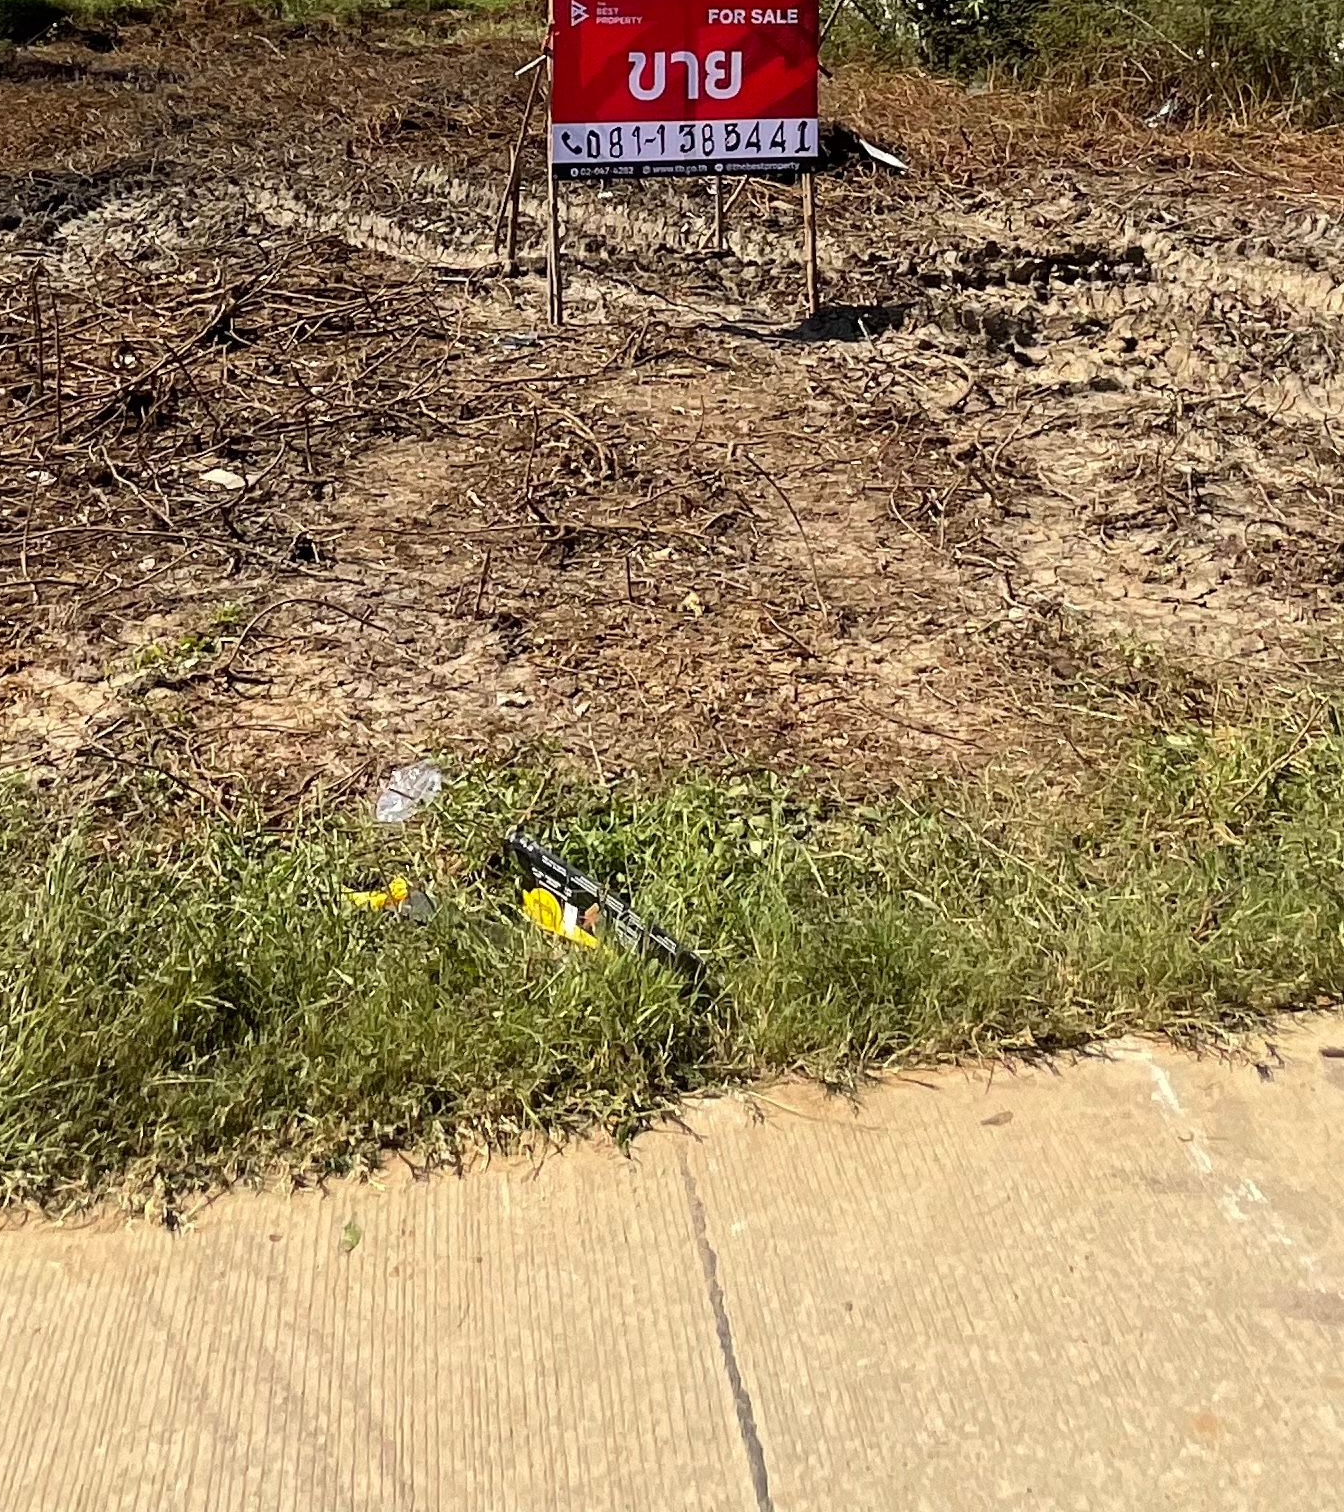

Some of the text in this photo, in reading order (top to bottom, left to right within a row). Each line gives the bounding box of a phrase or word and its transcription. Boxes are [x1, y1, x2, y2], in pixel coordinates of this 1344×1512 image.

[597, 7, 619, 16] BEST
[708, 8, 798, 24] FOR SALE
[596, 16, 643, 25] PROPERTY
[628, 50, 743, 101] ขาย
